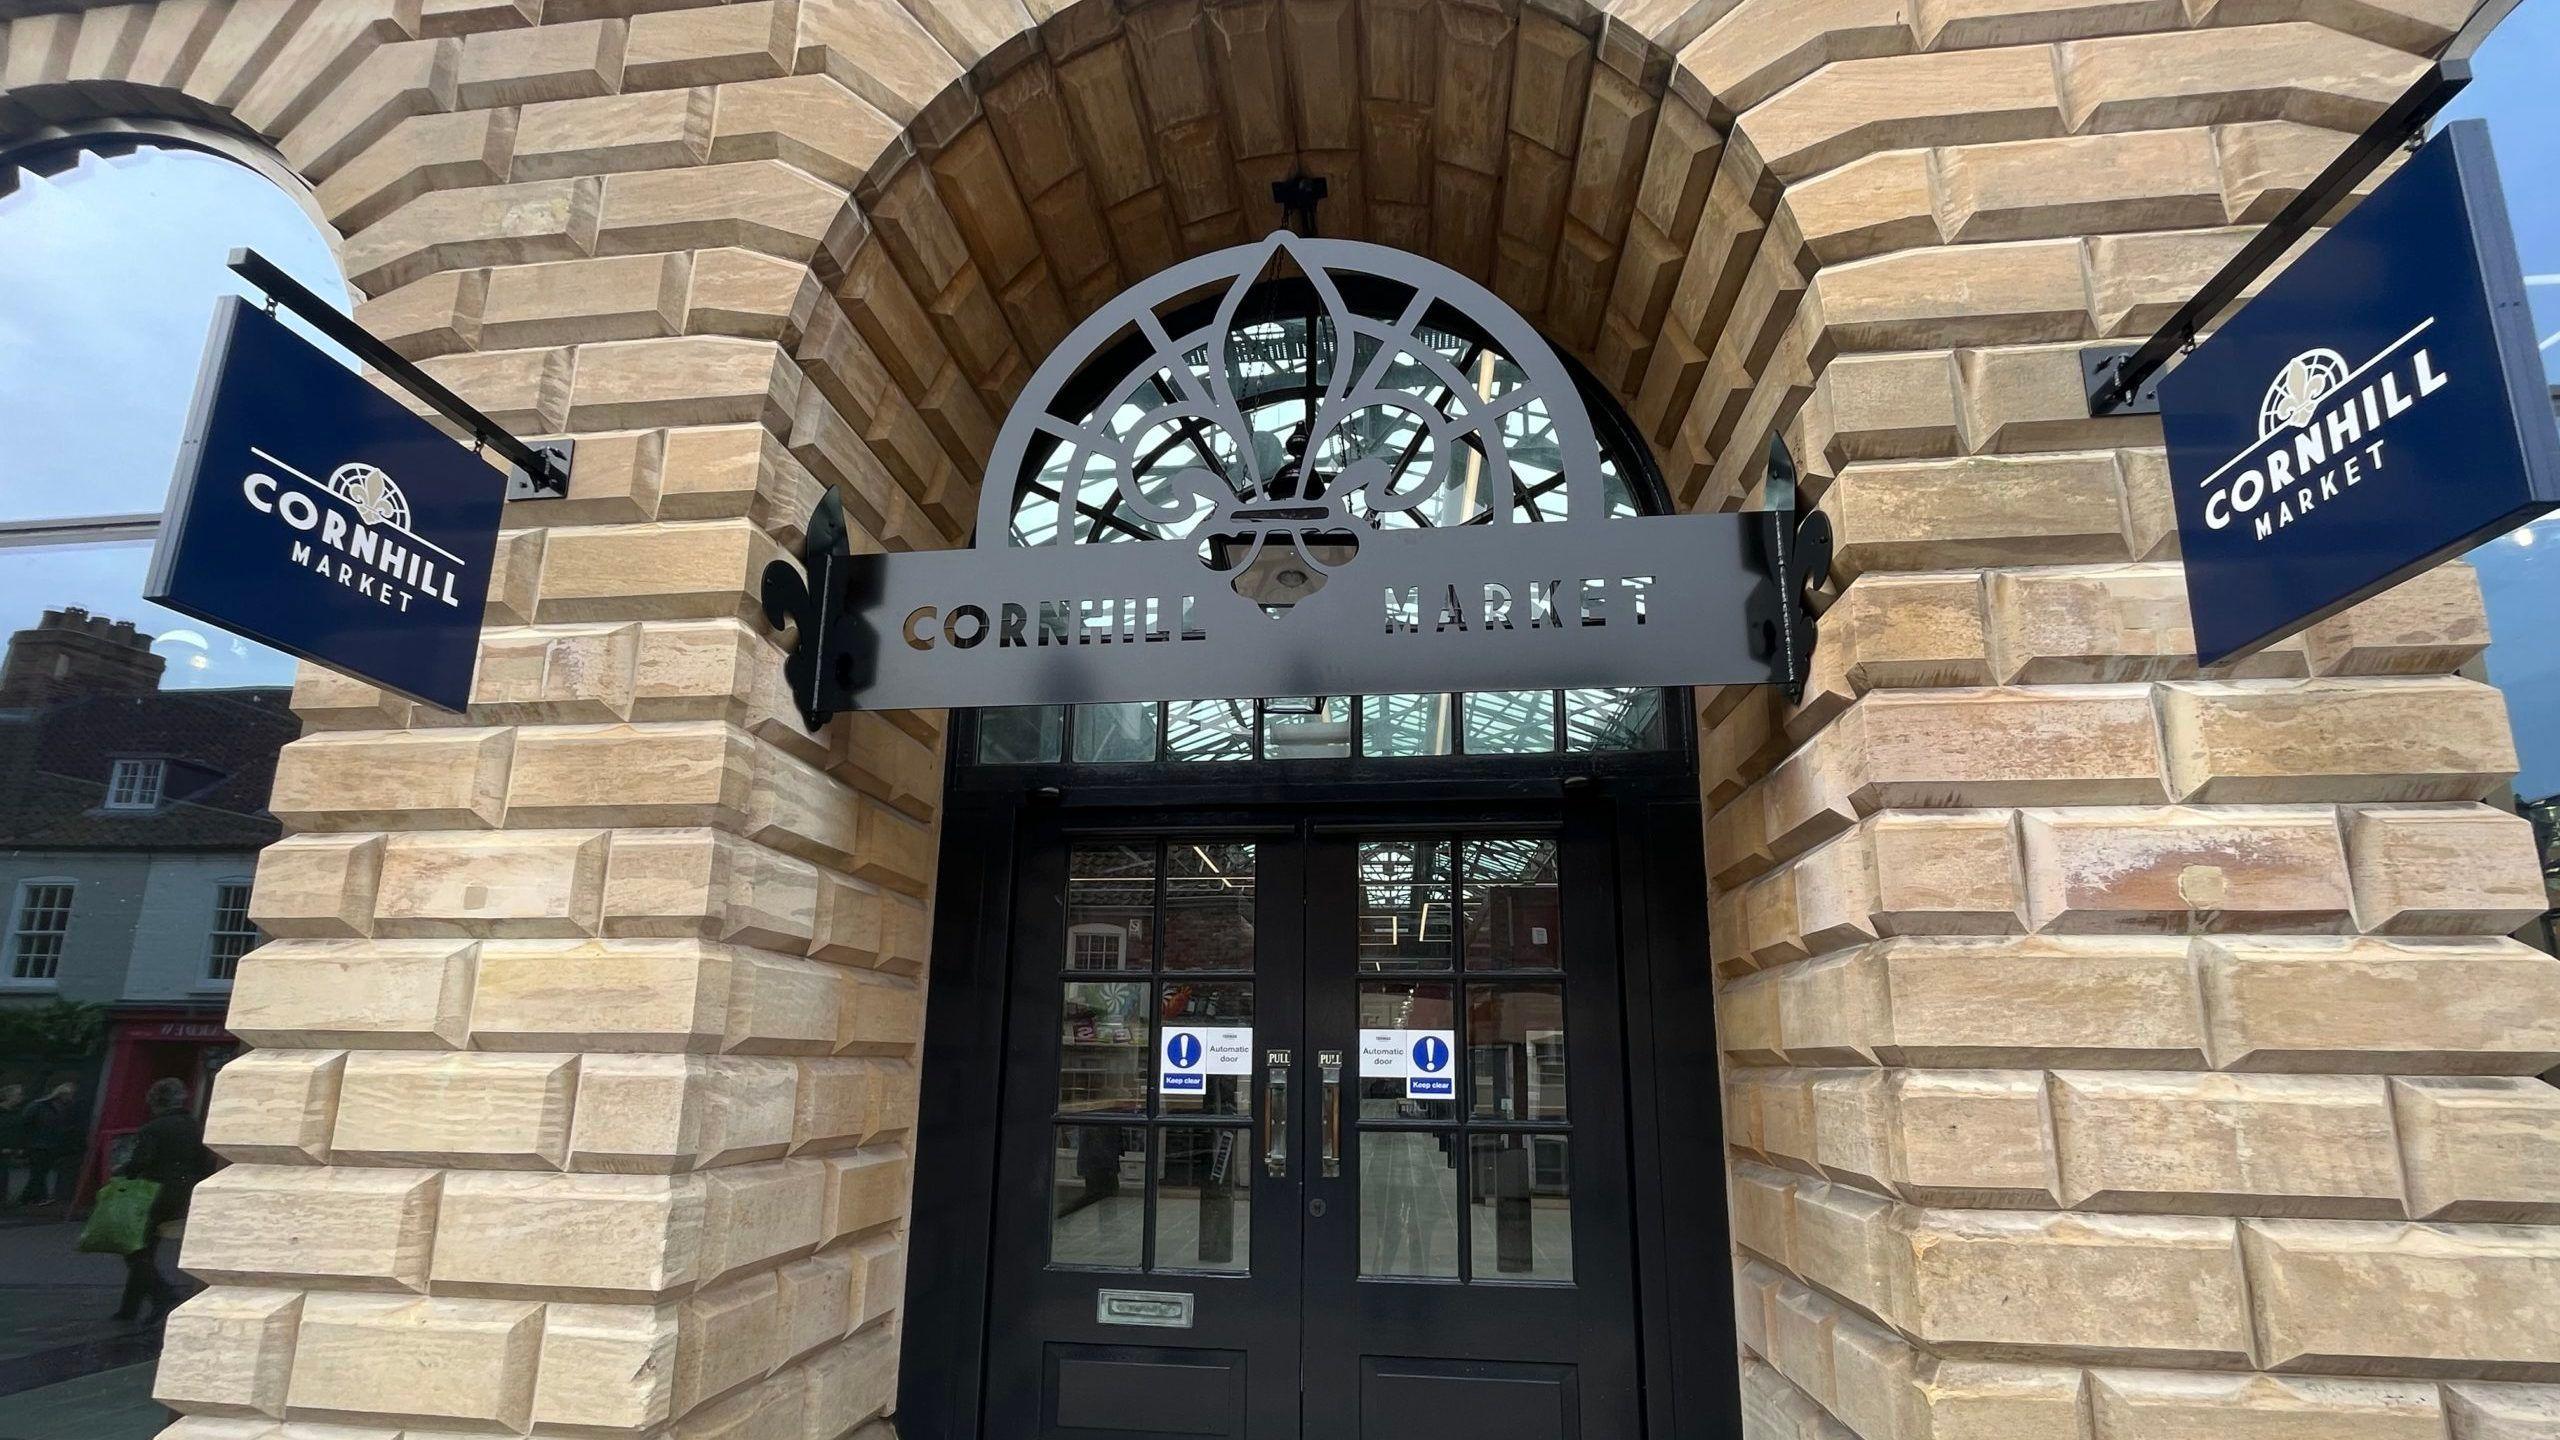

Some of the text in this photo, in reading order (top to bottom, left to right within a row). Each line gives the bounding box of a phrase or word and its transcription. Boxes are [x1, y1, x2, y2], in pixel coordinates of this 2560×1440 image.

[2205, 348, 2449, 530] CORNHILL
[2254, 440, 2385, 541] MARKET
[243, 473, 459, 607] CORNHILL
[291, 541, 413, 612] MARKET
[903, 575, 1656, 650] CORNHILL MARKET
[1209, 1045, 1249, 1053] Automatic
[1363, 1047, 1404, 1055] Automatic
[1220, 1055, 1238, 1063] door
[1269, 1053, 1290, 1064] PULL
[1320, 1054, 1342, 1065] PULL
[1374, 1057, 1393, 1065] door
[1166, 1077, 1201, 1086] Keep clear
[1412, 1081, 1449, 1090] Keep clear
